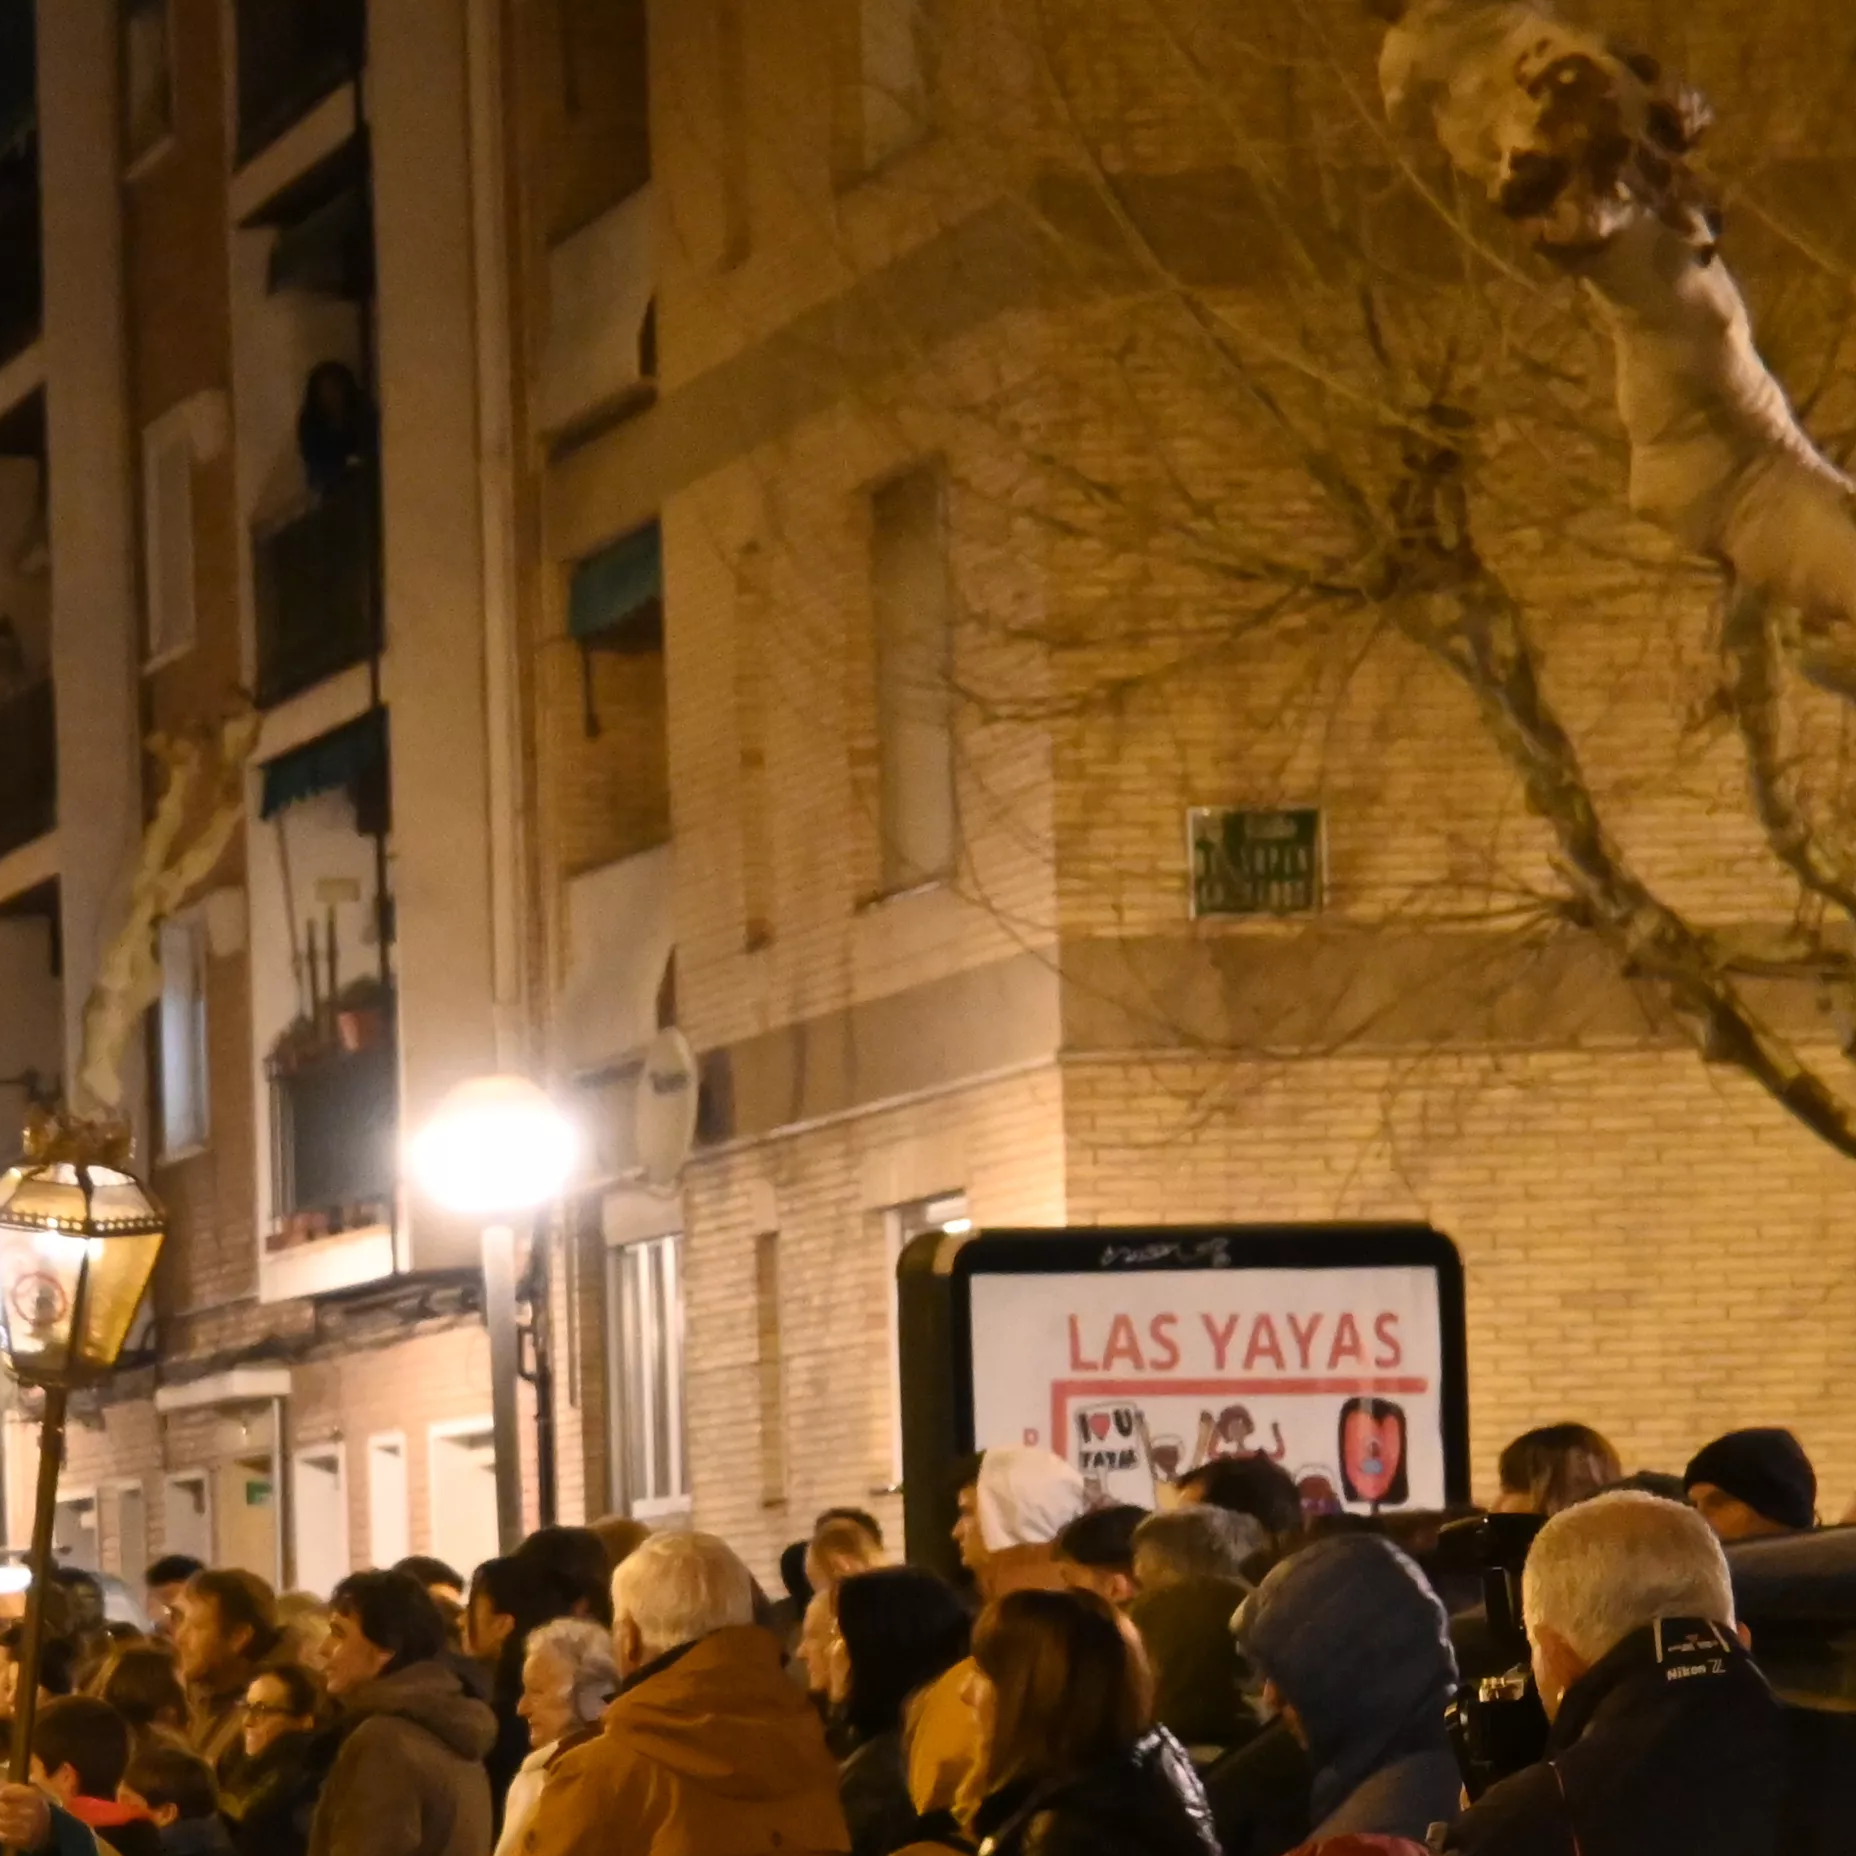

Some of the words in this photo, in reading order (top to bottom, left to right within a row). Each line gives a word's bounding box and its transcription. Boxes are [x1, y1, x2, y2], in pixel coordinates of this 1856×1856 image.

[1066, 1312, 1181, 1371] LAS
[1199, 1312, 1403, 1371] YAYAS
[1113, 1407, 1134, 1438] U
[1666, 1665, 1707, 1681] Nikon
